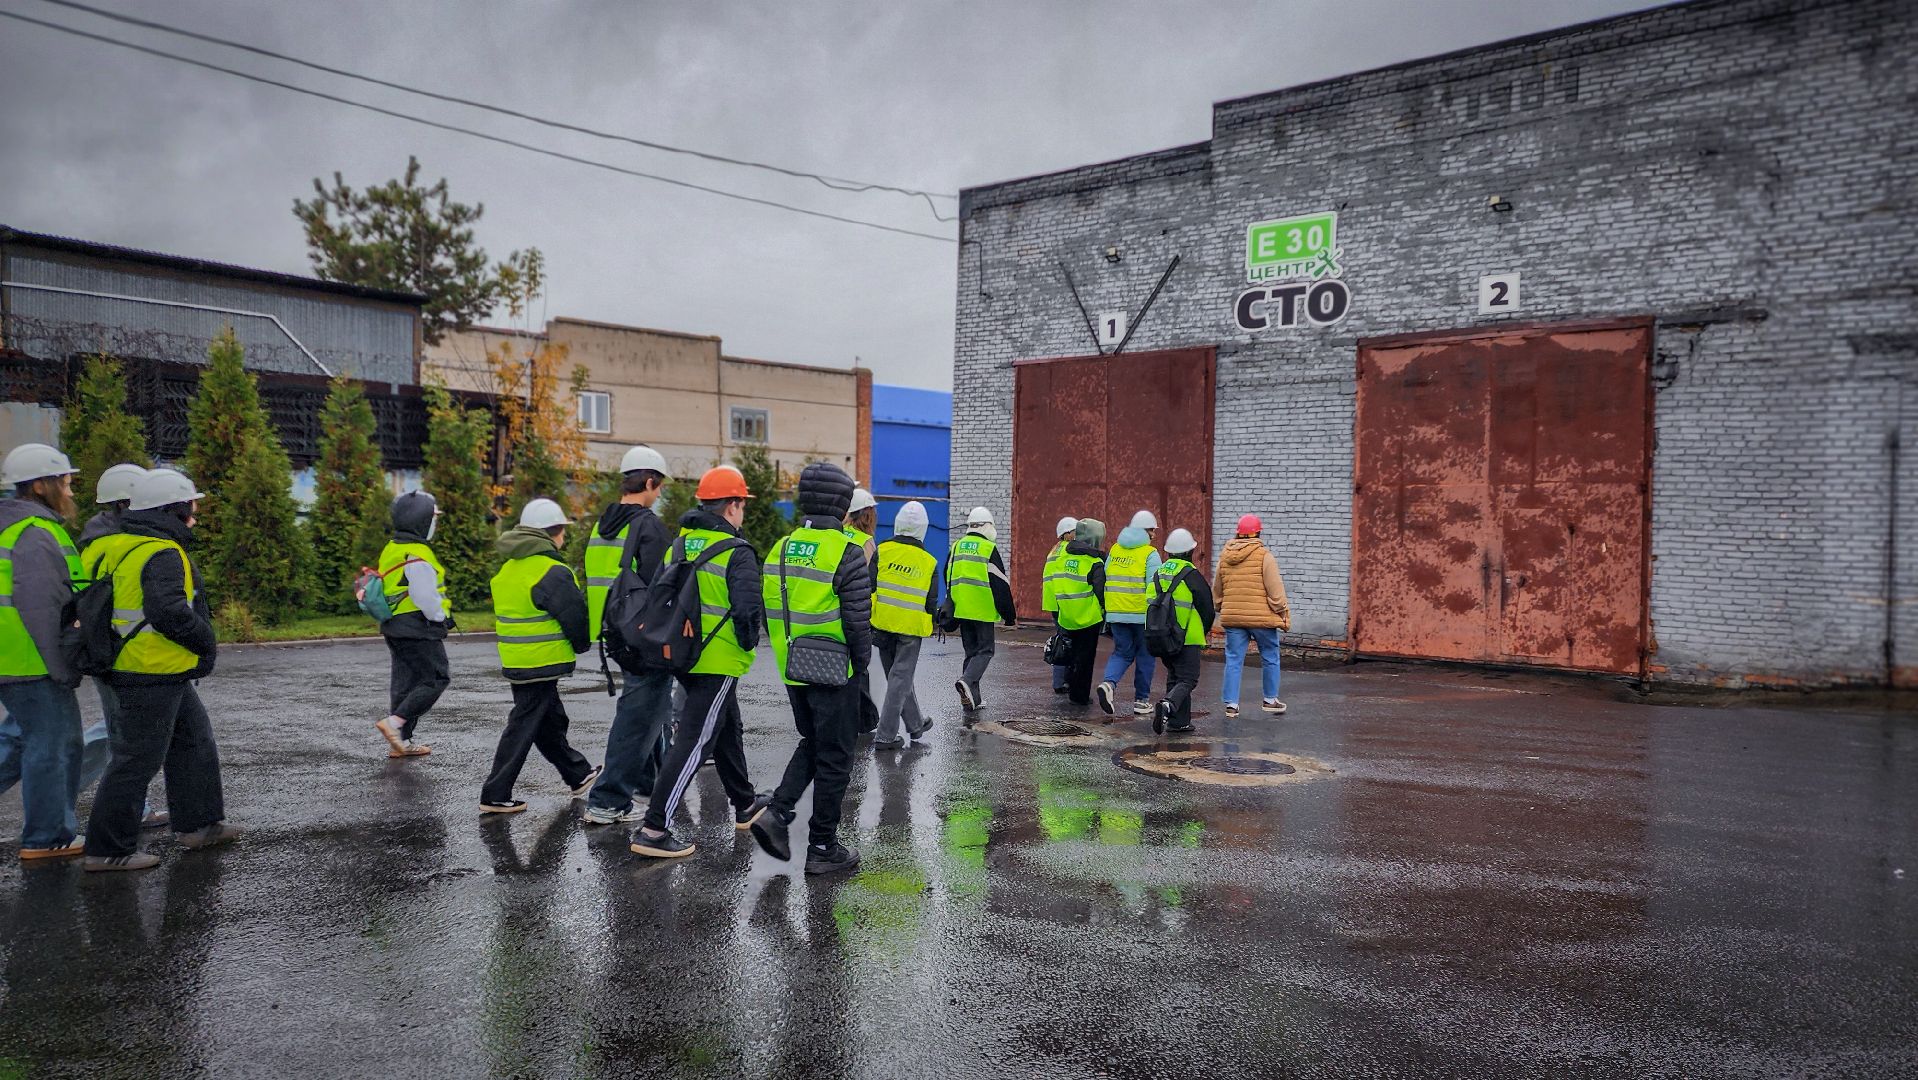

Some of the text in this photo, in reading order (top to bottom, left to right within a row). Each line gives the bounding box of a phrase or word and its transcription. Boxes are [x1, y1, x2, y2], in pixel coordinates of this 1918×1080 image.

[1258, 225, 1324, 257] E 30
[1250, 261, 1316, 281] ЦЕНТР
[1490, 281, 1508, 306] 2
[1237, 281, 1348, 329] СТО
[1107, 319, 1116, 338] 1
[691, 539, 705, 550] 30
[787, 542, 815, 555] E 30
